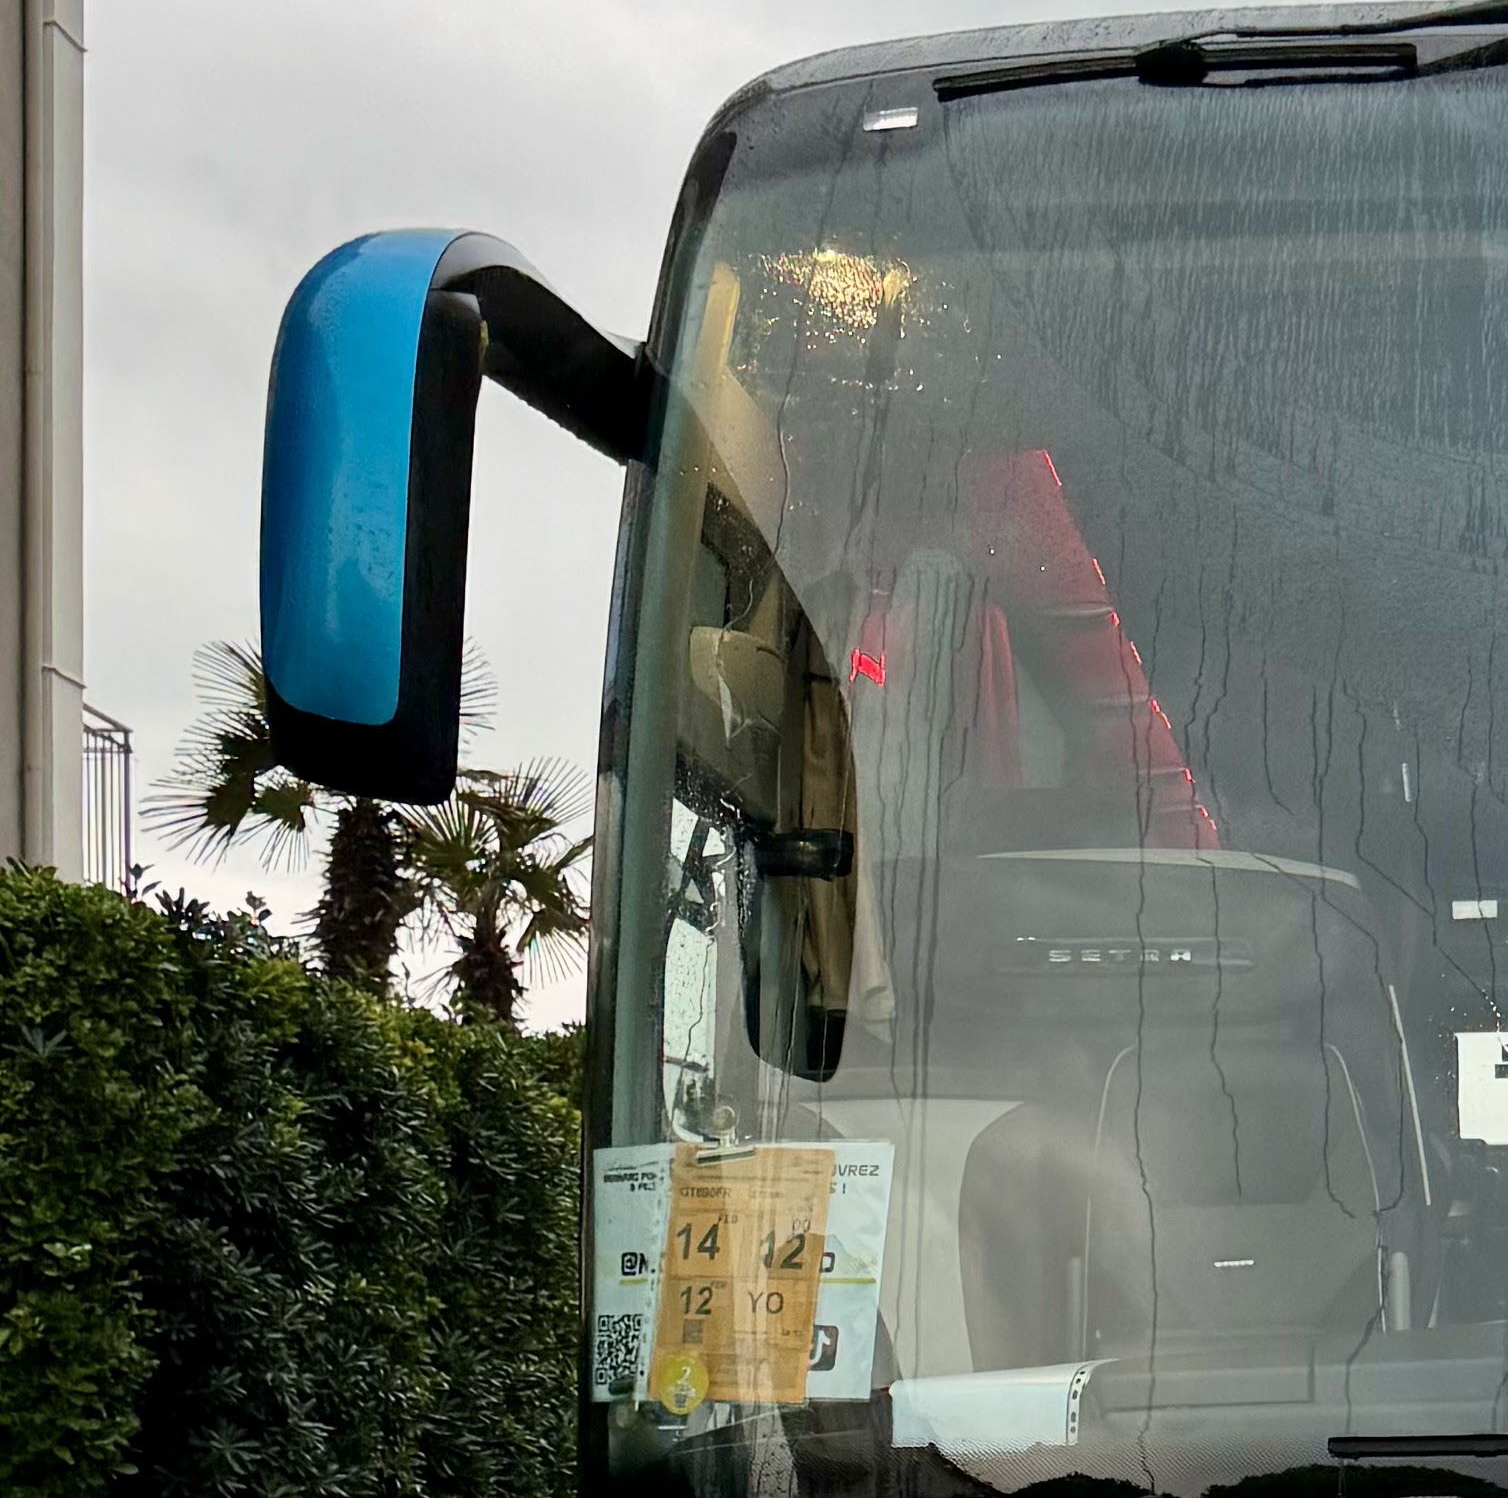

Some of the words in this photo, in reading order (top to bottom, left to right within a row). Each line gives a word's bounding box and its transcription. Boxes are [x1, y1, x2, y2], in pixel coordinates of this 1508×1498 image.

[1048, 948, 1192, 963] SETRA
[676, 1222, 720, 1260] 14
[760, 1230, 806, 1270] 12
[680, 1285, 713, 1315] 12
